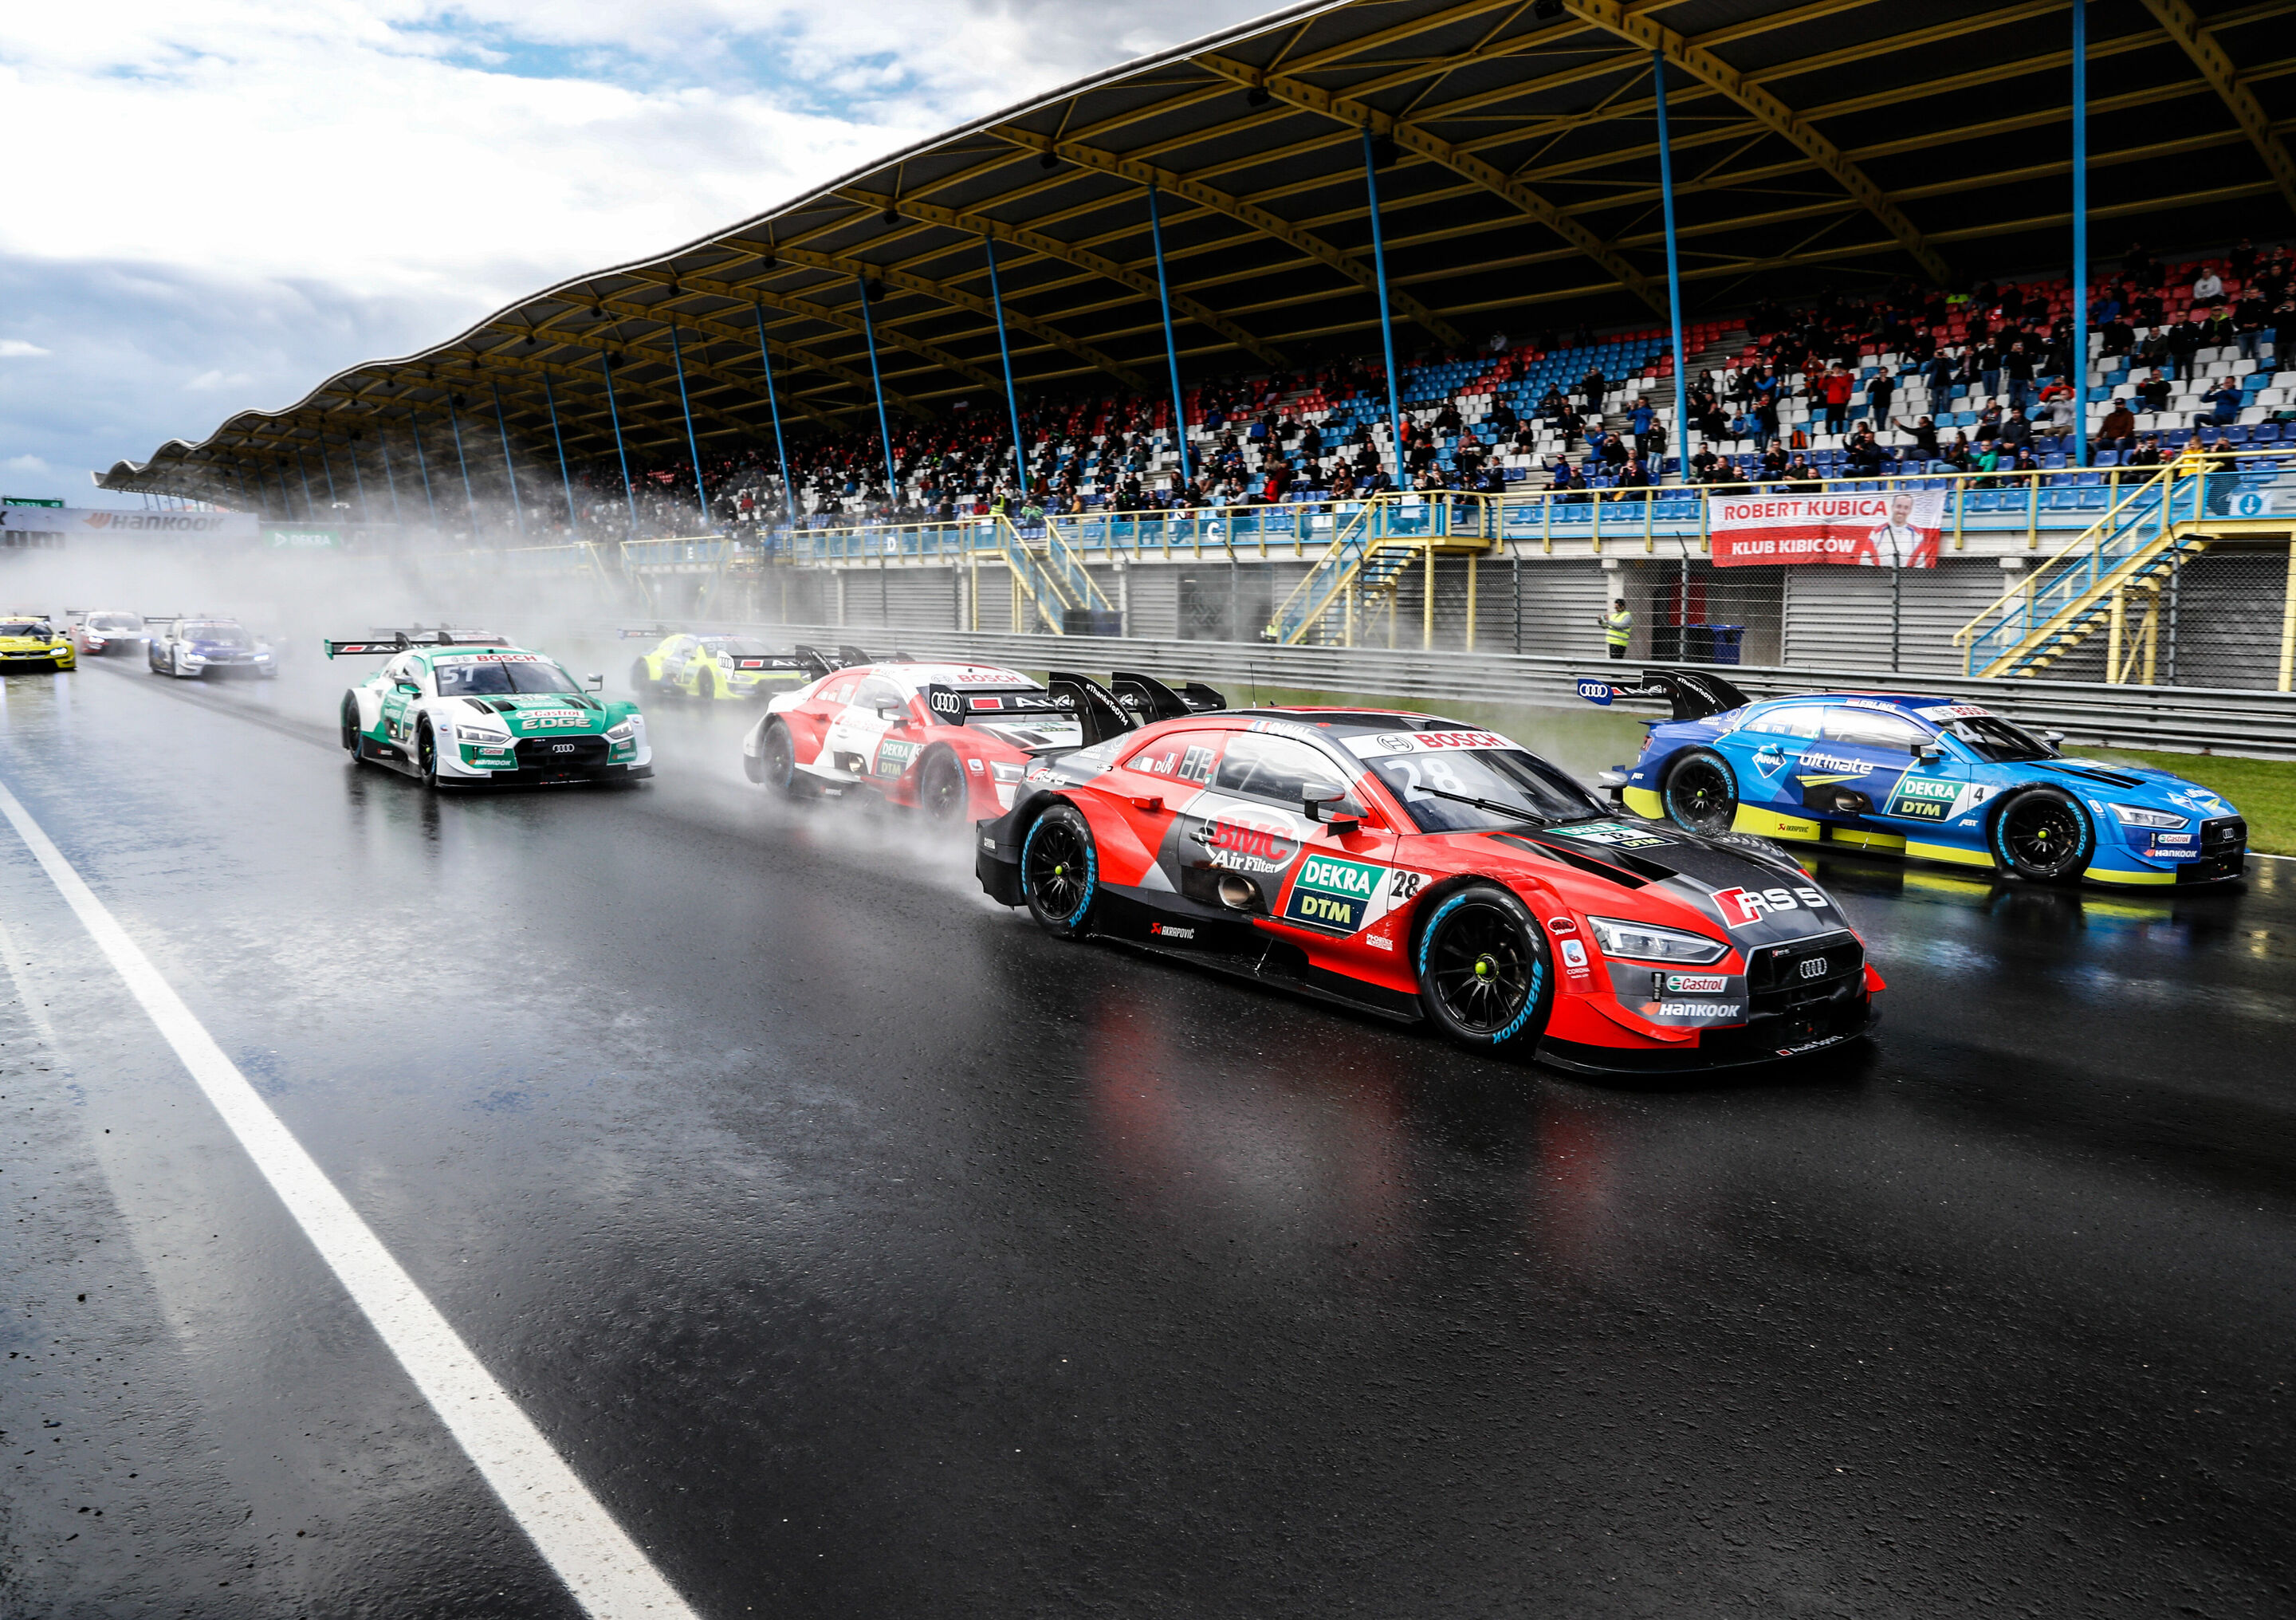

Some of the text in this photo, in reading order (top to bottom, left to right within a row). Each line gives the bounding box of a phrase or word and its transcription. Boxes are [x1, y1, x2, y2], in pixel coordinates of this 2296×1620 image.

[1724, 500, 1887, 520] ROBERT KUBICA
[1207, 522, 1220, 541] C
[887, 537, 896, 552] D
[1732, 536, 1855, 555] KLUB KIBICÓW
[441, 666, 474, 684] 51
[957, 674, 1022, 683] BOSCH
[1677, 677, 1716, 705] #ThanksToDTM
[1086, 683, 1129, 726] #ThanksToDTM
[522, 718, 592, 730] EDGE
[1771, 725, 1786, 734] FRI
[1952, 721, 1986, 743] 4
[1413, 733, 1508, 748] BOSCH
[882, 743, 909, 761] DEKRA
[1756, 754, 1783, 766] ARAL
[881, 762, 902, 775] DTM
[1154, 761, 1174, 774] DUV
[1799, 753, 1873, 774] ultimate
[1384, 757, 1468, 803] 28
[1905, 780, 1955, 799] DEKRA
[1974, 788, 1983, 802] 4
[1901, 800, 1940, 816] DTM
[1211, 815, 1294, 860] BMC
[1622, 838, 1666, 847] DTM
[2165, 834, 2189, 843] Castrol
[1211, 850, 1276, 873] Air Filter
[1305, 861, 1370, 894] DEKRA
[1391, 871, 1420, 899] 28
[1300, 895, 1351, 924] DTM
[1734, 887, 1829, 919] RS 5
[1681, 978, 1724, 990] Castrol
